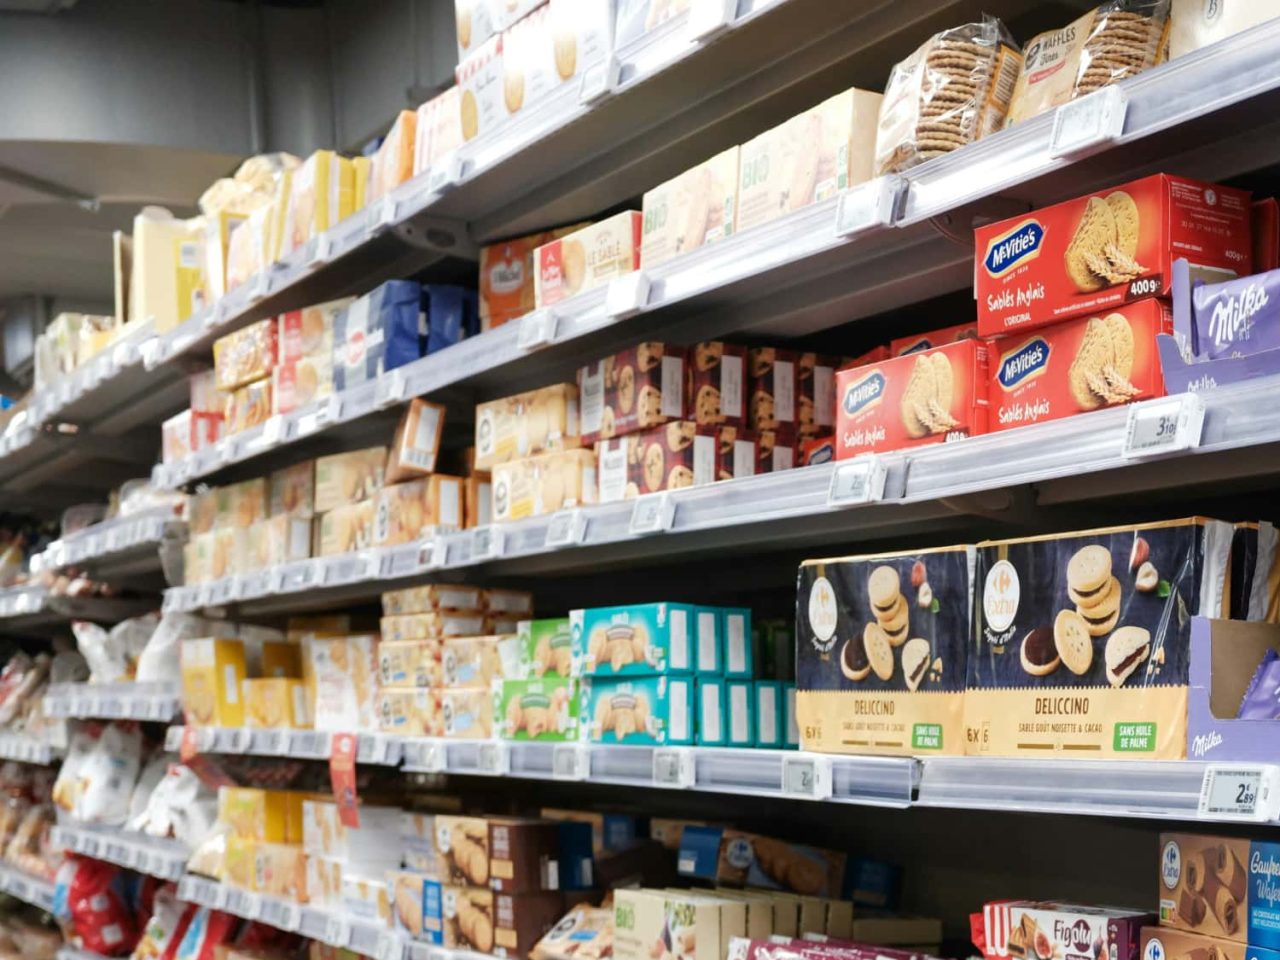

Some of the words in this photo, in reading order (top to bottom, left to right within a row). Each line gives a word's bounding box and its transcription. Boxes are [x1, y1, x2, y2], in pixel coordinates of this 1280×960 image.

[988, 289, 1014, 312] Sablés
[1016, 284, 1045, 306] Anglais
[1004, 314, 1031, 327] L'ORIGINAL
[1209, 283, 1269, 346] Milka
[999, 405, 1022, 423] Sablés
[1024, 399, 1050, 421] Anglais
[854, 700, 895, 715] DELICCINO
[1035, 698, 1089, 715] DELICCINO
[1051, 722, 1077, 733] NOISETTE
[1085, 723, 1102, 733] CACAO
[1120, 725, 1135, 736] SANS
[1137, 725, 1152, 736] HUILE
[1120, 738, 1128, 748] DE
[1130, 737, 1148, 748] PALME
[1192, 730, 1223, 757] Milka
[1054, 919, 1091, 948] Figolu
